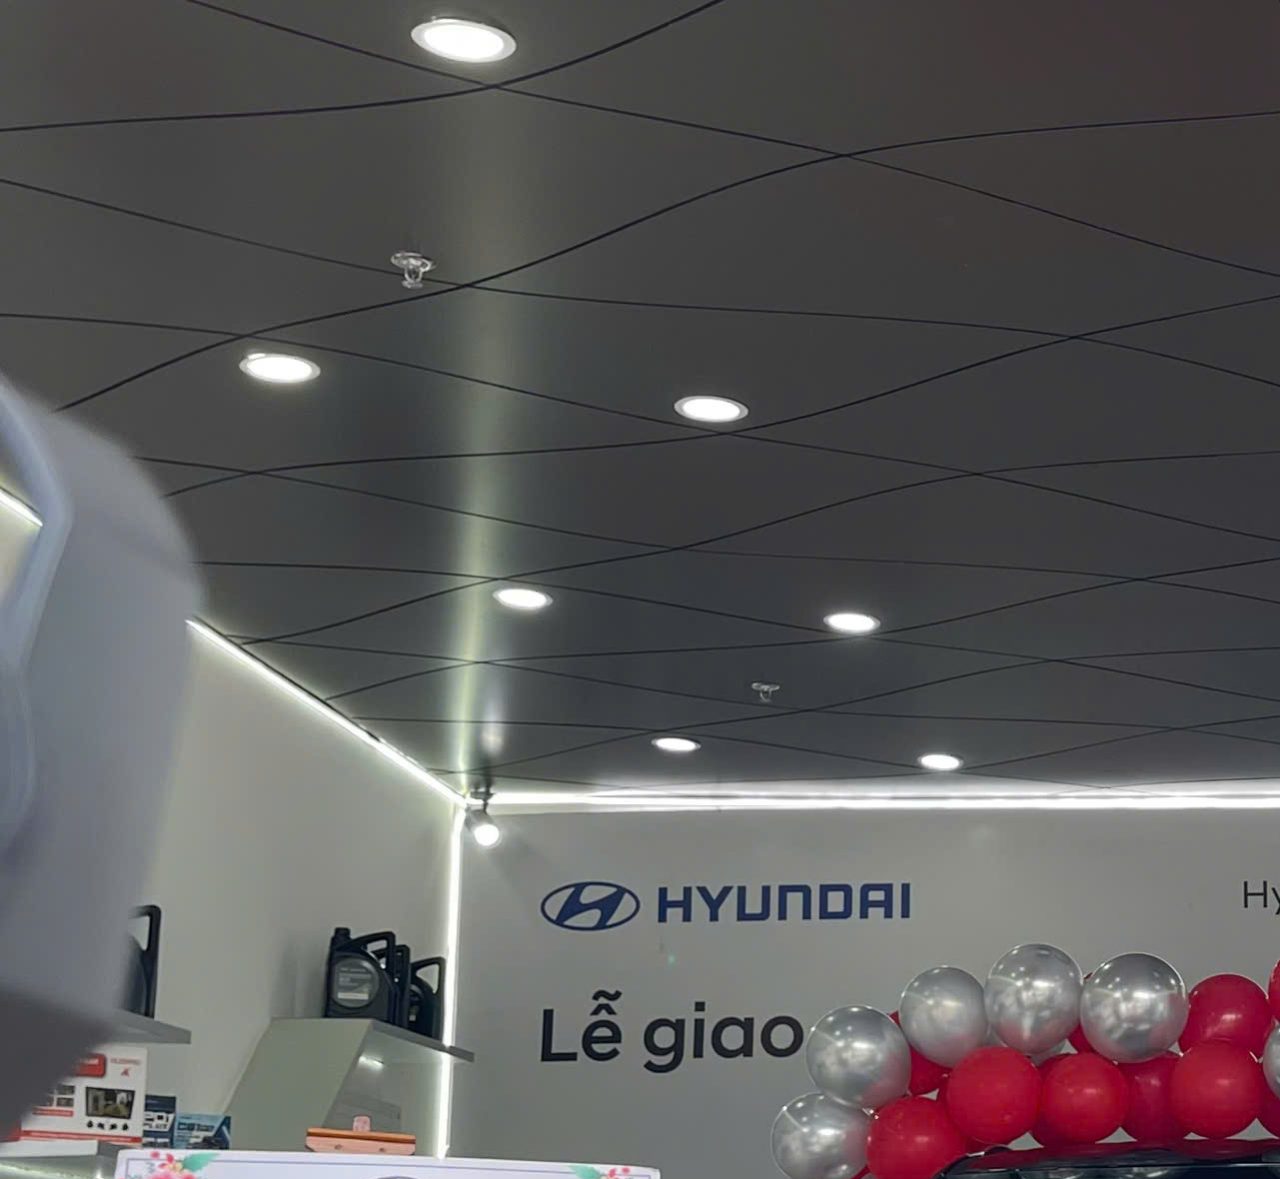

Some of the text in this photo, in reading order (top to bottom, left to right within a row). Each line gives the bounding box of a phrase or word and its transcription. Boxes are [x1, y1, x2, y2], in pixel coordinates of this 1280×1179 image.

[657, 882, 911, 923] HYUNDAI
[540, 989, 805, 1074] Lễ giao
